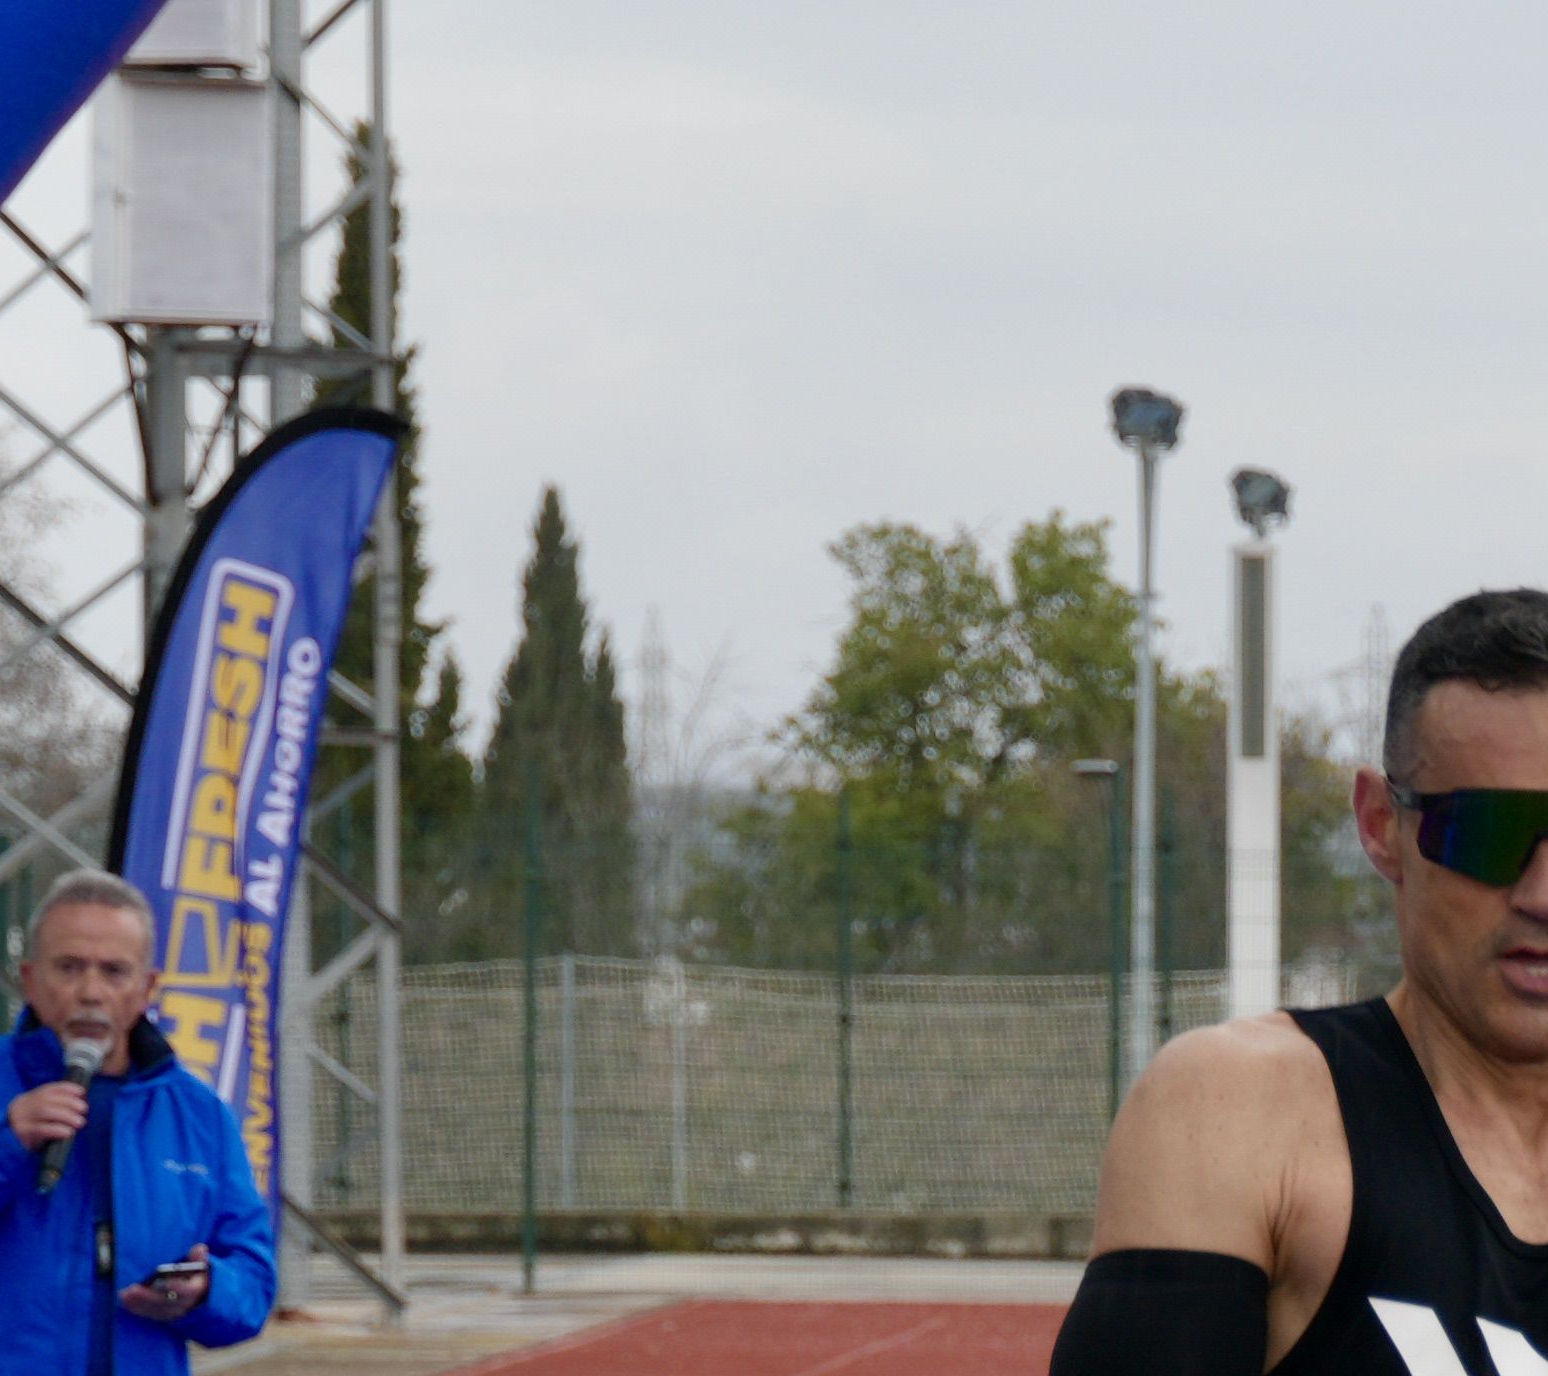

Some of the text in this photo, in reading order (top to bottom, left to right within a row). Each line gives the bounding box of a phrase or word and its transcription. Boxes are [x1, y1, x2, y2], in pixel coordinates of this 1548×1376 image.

[177, 580, 278, 900] FRESH
[256, 636, 322, 844] AHORRO
[245, 852, 284, 918] AL
